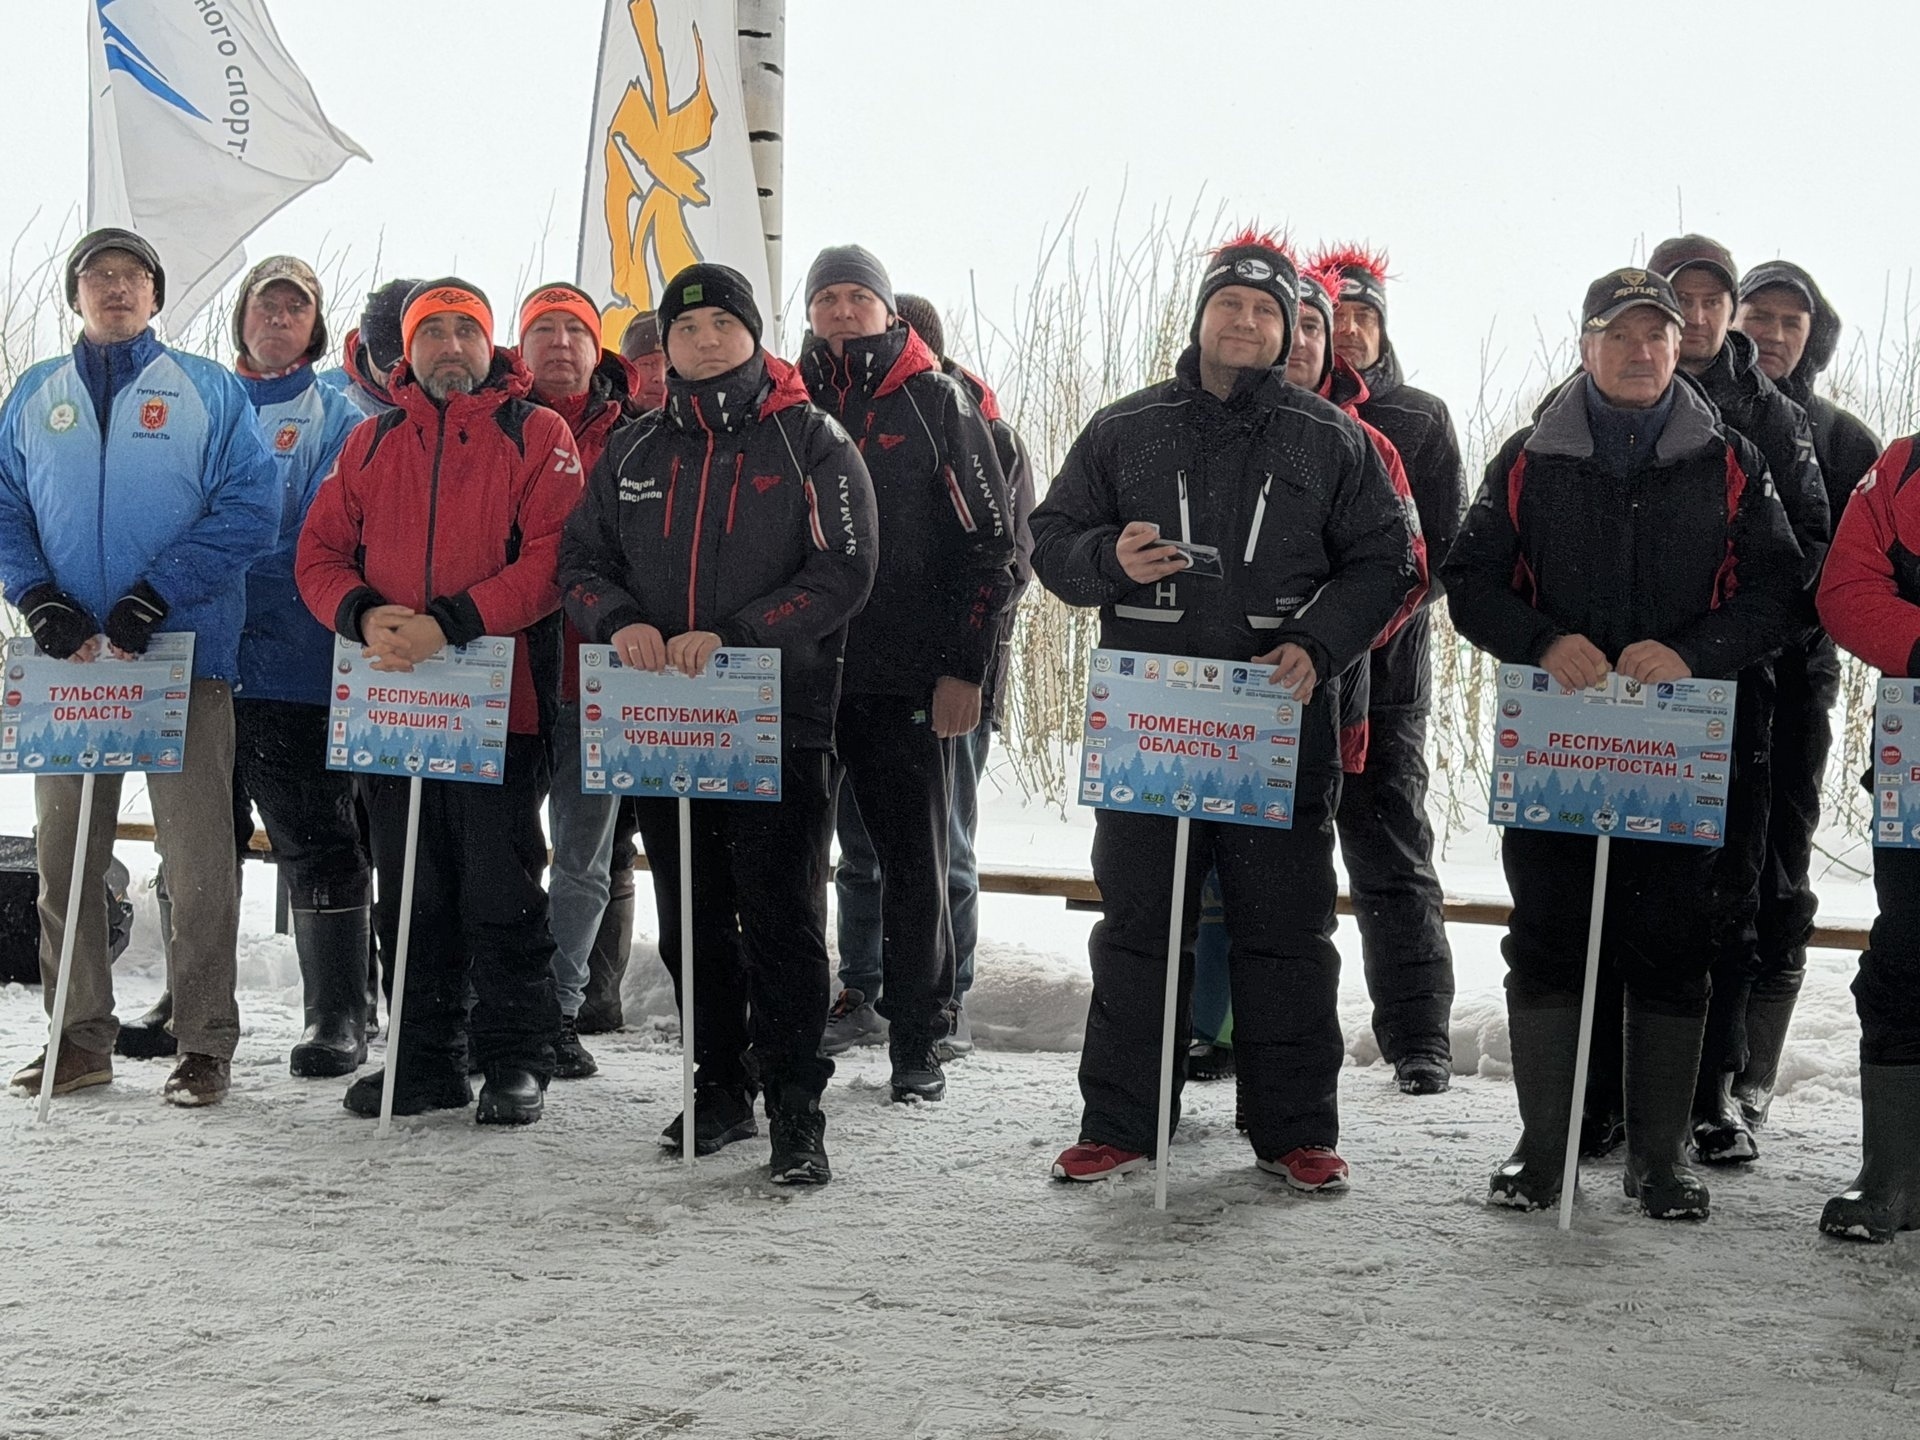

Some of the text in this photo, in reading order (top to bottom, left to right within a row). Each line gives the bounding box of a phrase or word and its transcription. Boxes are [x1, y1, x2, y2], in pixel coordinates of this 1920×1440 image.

[222, 65, 249, 160] спорт
[838, 475, 857, 556] SHAMAN
[50, 685, 143, 702] ТУЛЬСКАЯ
[367, 687, 471, 708] РЕСПУБЛИКА
[54, 706, 132, 721] ОБЛАСТЬ
[368, 711, 463, 731] ЧУВАШИЯ 1
[621, 706, 738, 724] РЕСПУБЛИКА
[1128, 712, 1256, 740] ТЮМЕНСКАЯ
[624, 730, 732, 748] ЧУВАШИЯ 2
[1139, 735, 1239, 761] ОБЛАСТЬ 1
[1548, 733, 1676, 757] РЕСПУБЛИКА
[1526, 751, 1677, 776] БАШКОРТОСТАН
[1683, 764, 1695, 779] 1
